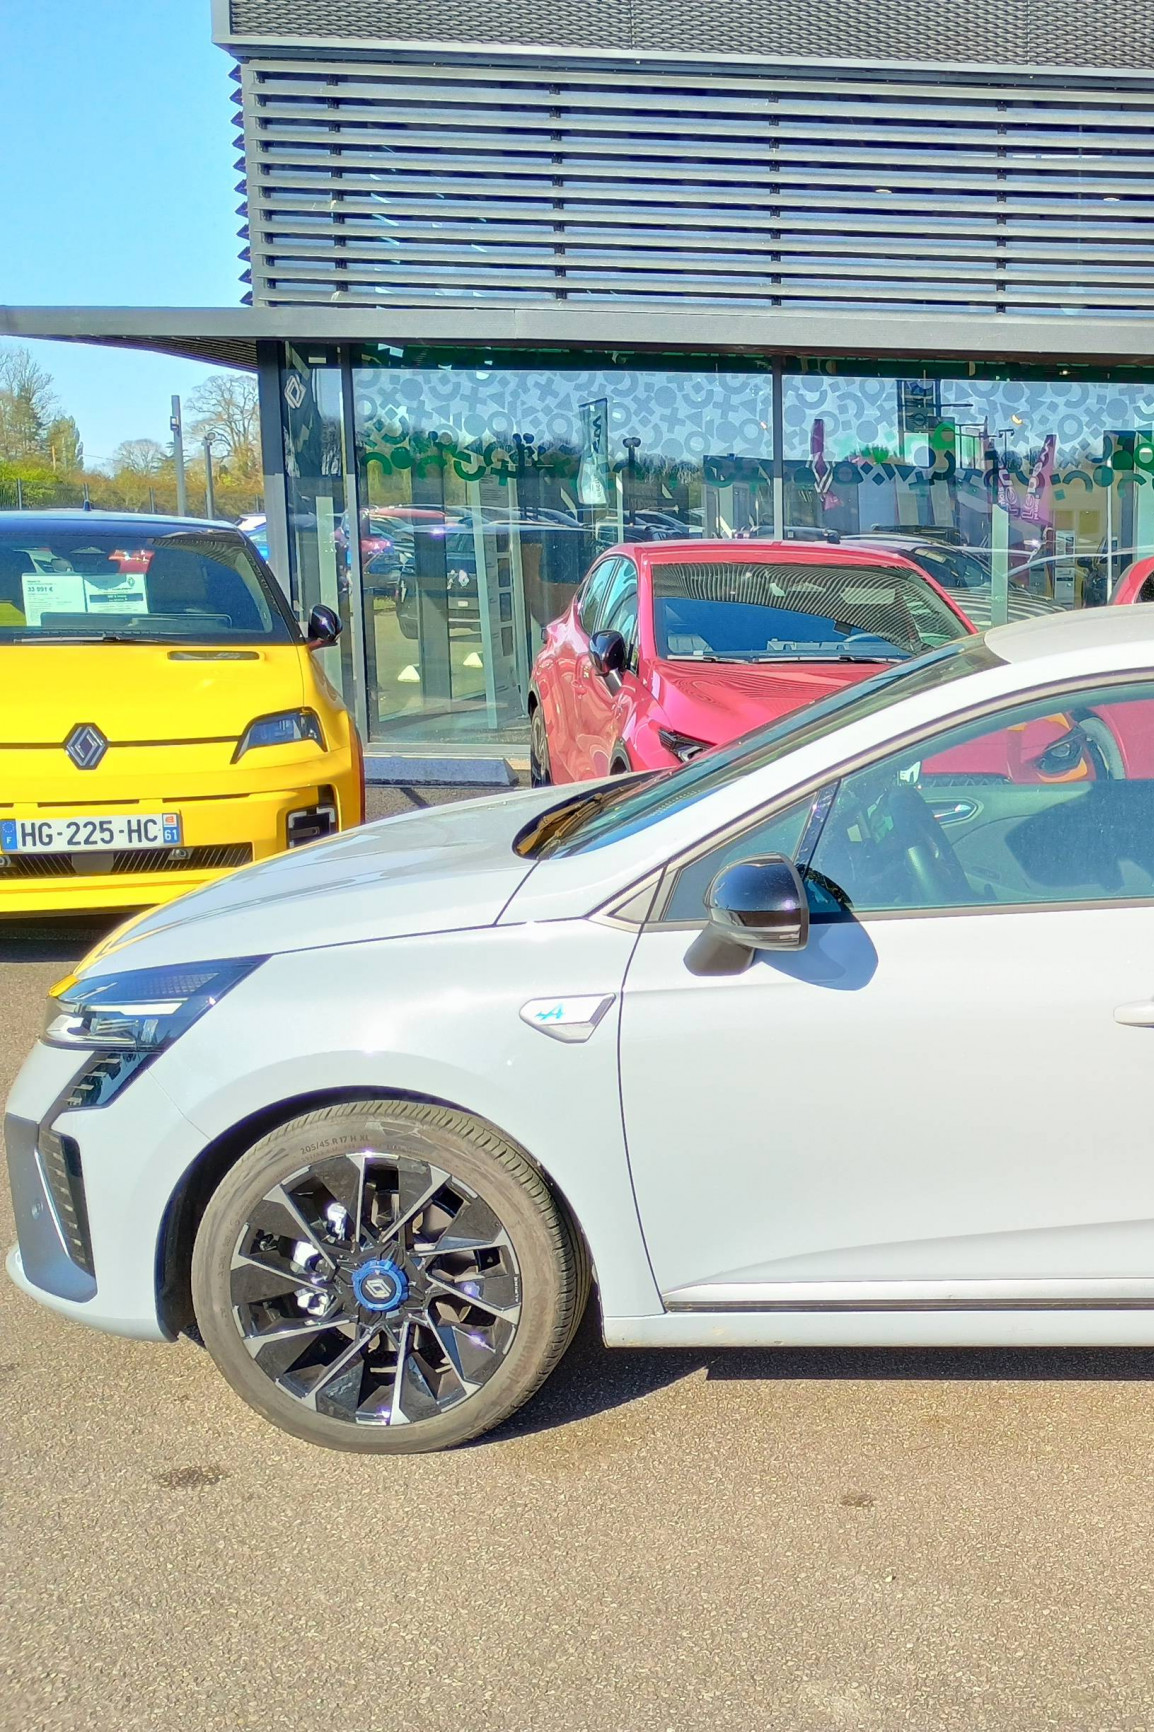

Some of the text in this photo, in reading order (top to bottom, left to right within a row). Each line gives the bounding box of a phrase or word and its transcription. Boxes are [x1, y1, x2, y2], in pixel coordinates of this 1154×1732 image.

[20, 819, 158, 847] HG-225-HC
[164, 829, 178, 841] 61
[300, 1140, 330, 1154] 205/45
